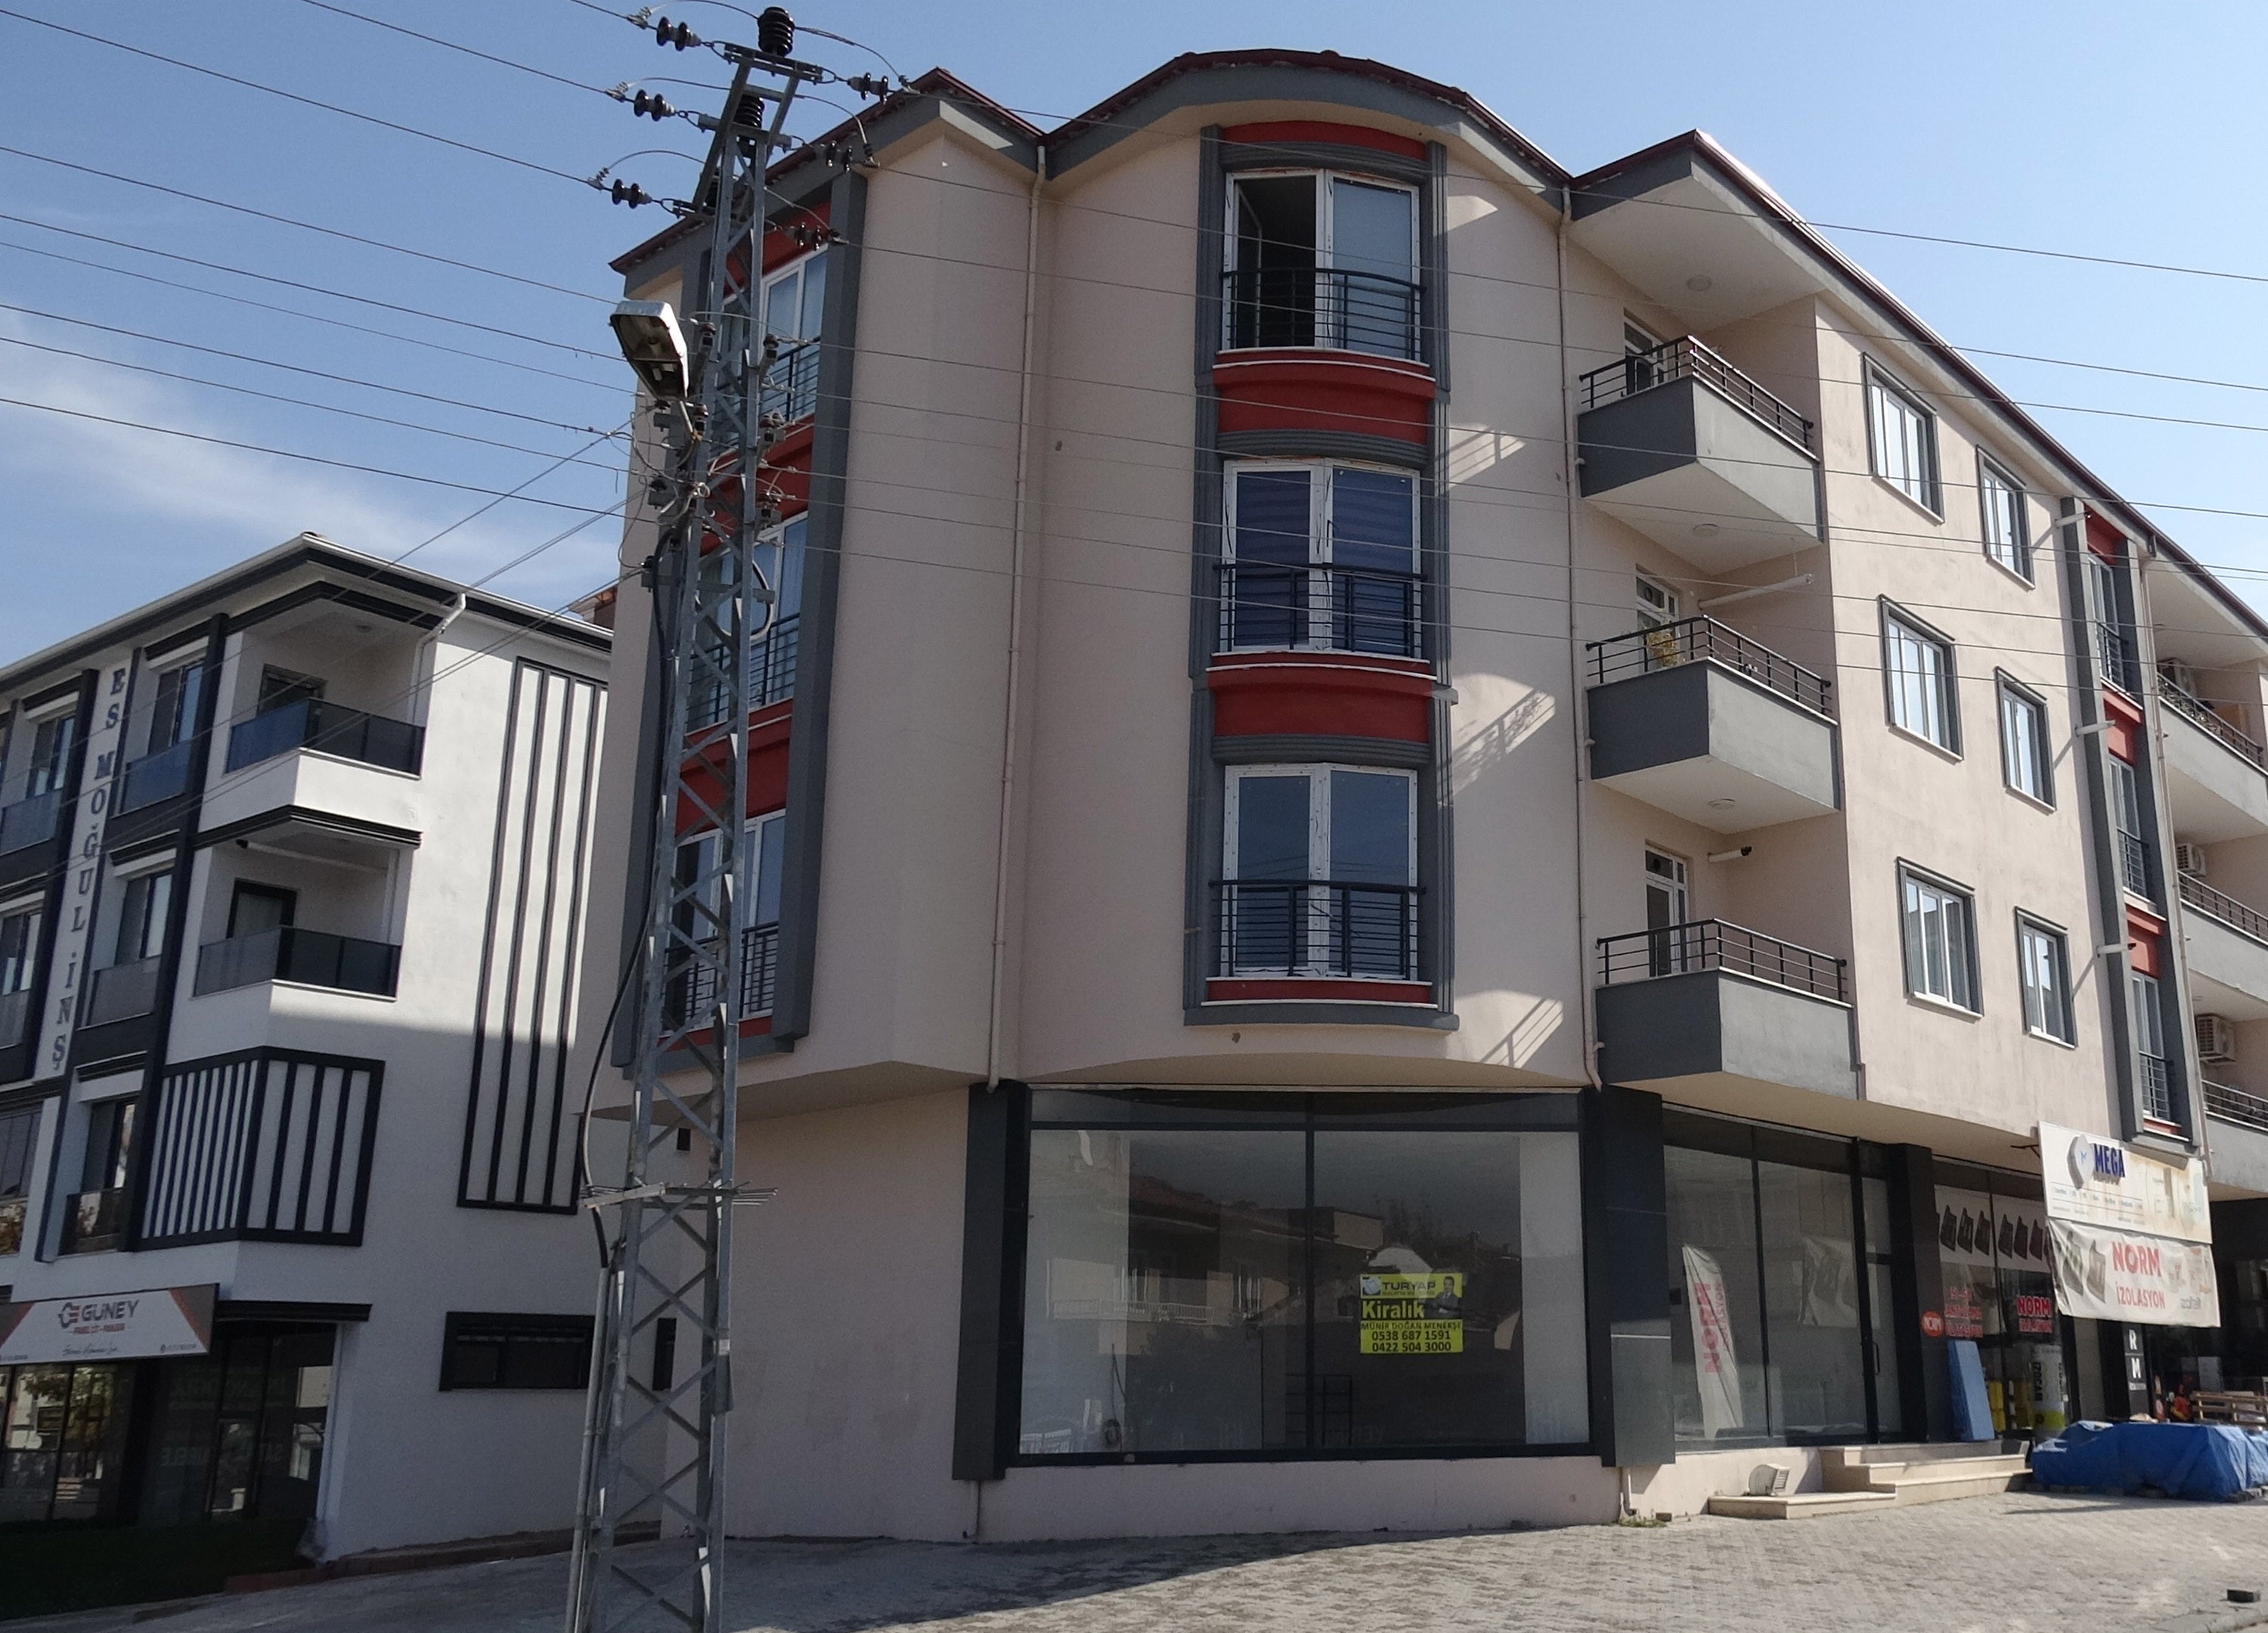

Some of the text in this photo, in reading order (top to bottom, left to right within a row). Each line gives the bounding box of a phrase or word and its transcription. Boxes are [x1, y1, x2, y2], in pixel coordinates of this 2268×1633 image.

[2093, 1143, 2125, 1177] MEGA
[2112, 1241, 2162, 1277] NORM
[1382, 1281, 1436, 1291] TURYAP
[2115, 1281, 2166, 1309] İZOLASYON
[1362, 1300, 1425, 1318] Kiralık
[2017, 1296, 2050, 1316] NORM
[1372, 1331, 1450, 1340] 0538 687 1591
[1393, 1322, 1421, 1330] DOĞAN
[1694, 1282, 1721, 1373] NORM
[1372, 1341, 1451, 1352] 0422 504 3000
